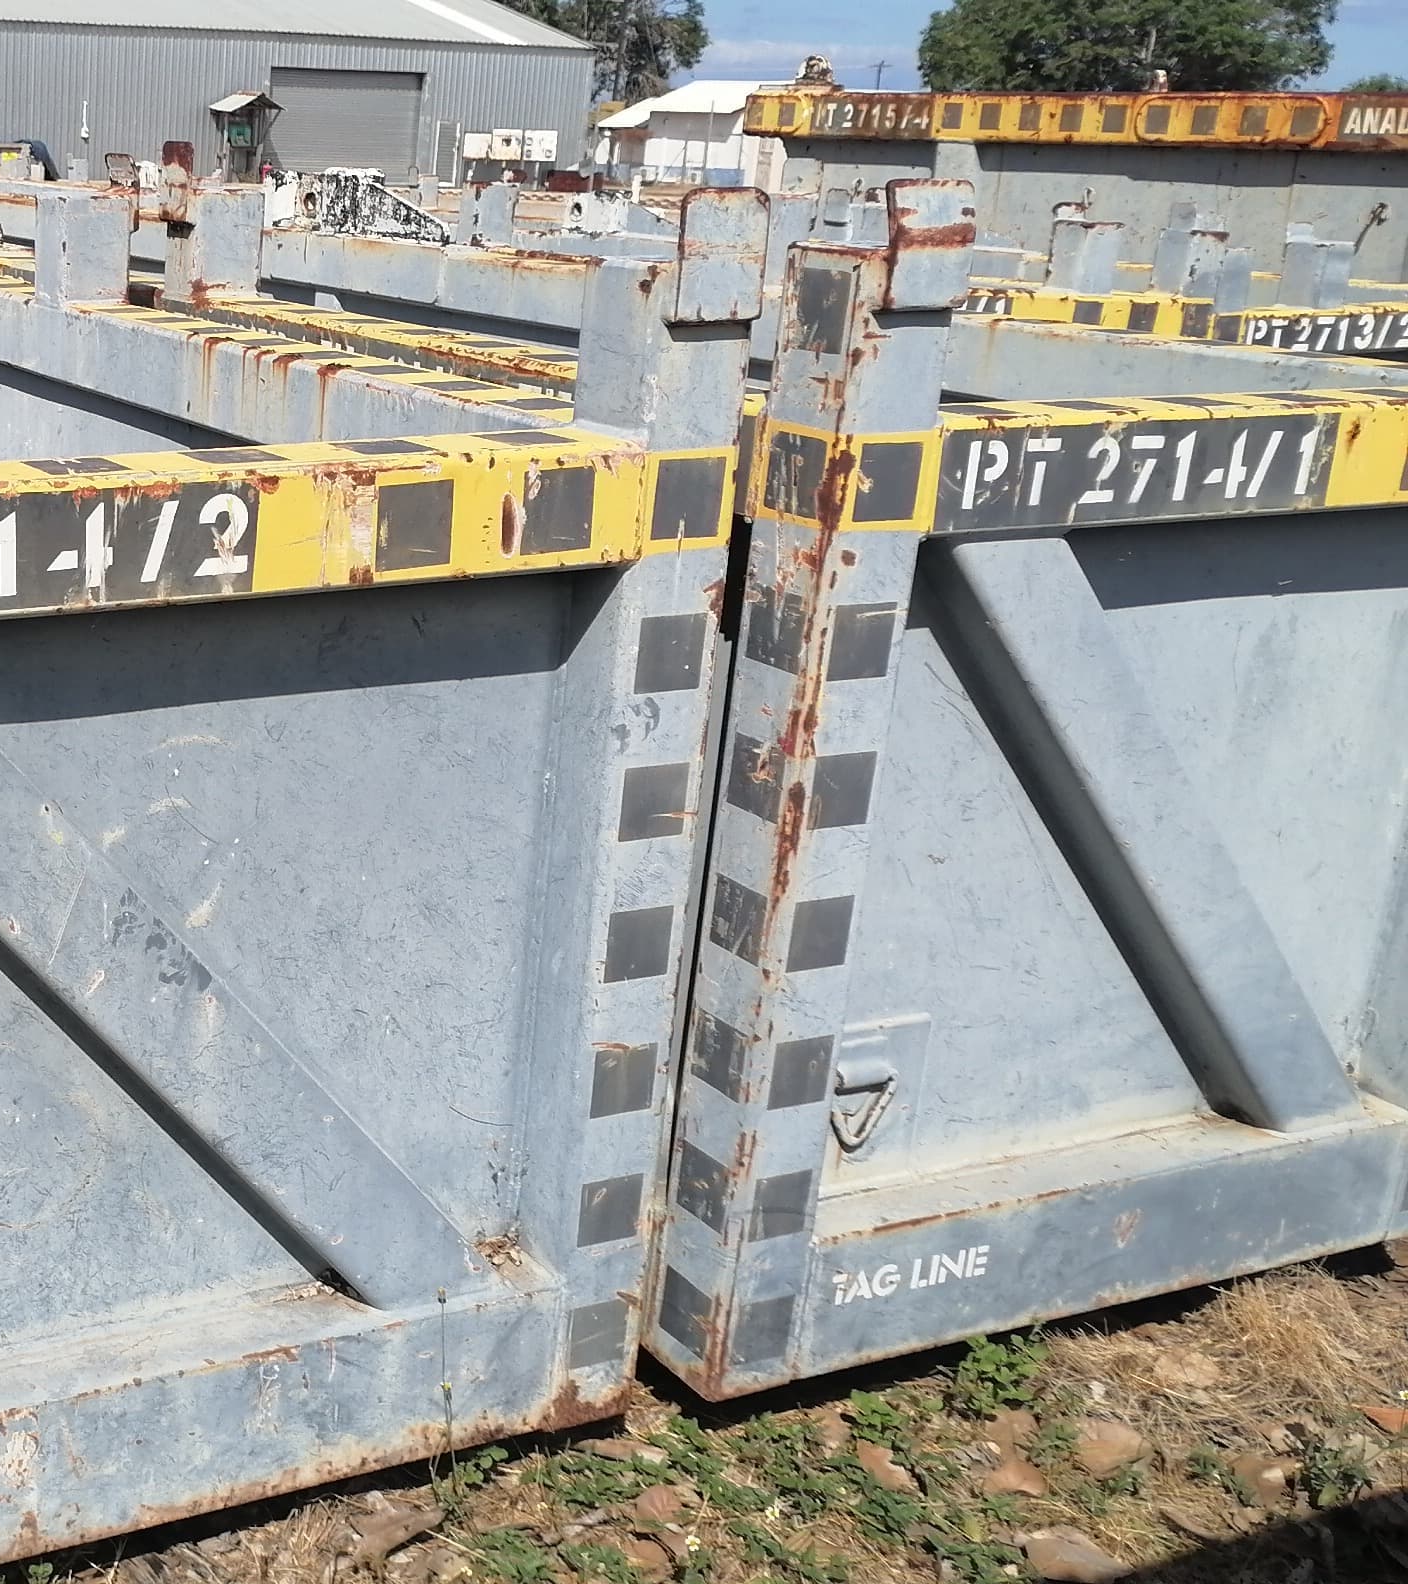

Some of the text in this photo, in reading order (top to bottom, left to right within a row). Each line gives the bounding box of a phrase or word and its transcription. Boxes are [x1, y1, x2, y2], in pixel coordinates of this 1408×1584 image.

[843, 103, 930, 129] 2715/4
[1246, 313, 1408, 352] PT 2713/2
[962, 425, 1320, 509] PT 2714/1
[832, 1244, 990, 1306] TAG LINE
